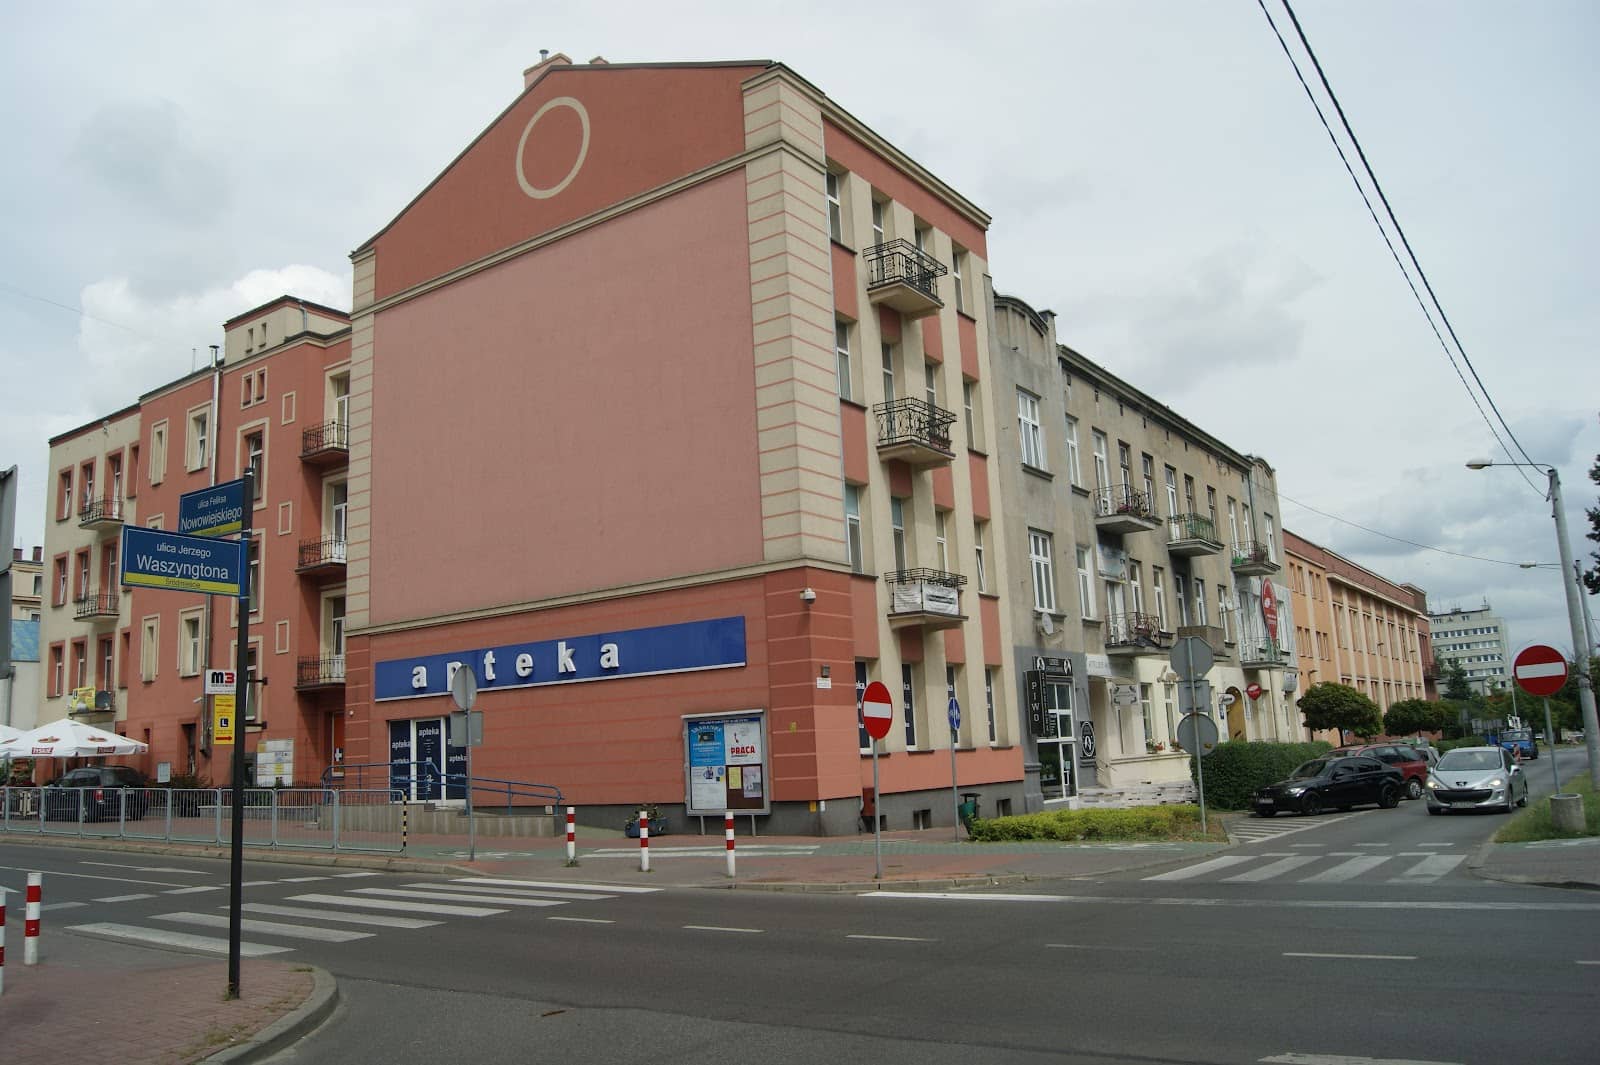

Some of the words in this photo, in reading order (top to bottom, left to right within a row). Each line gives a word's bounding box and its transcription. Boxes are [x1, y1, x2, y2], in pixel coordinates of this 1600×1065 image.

[197, 498, 209, 509] ulica
[180, 506, 243, 530] Nowowiejskiego
[156, 543, 176, 553] ulica
[178, 545, 211, 559] Jerzego
[136, 554, 229, 580] Waszyngtona
[1031, 681, 1040, 722] PIWO
[418, 727, 439, 737] apteka
[730, 745, 756, 754] PRACA
